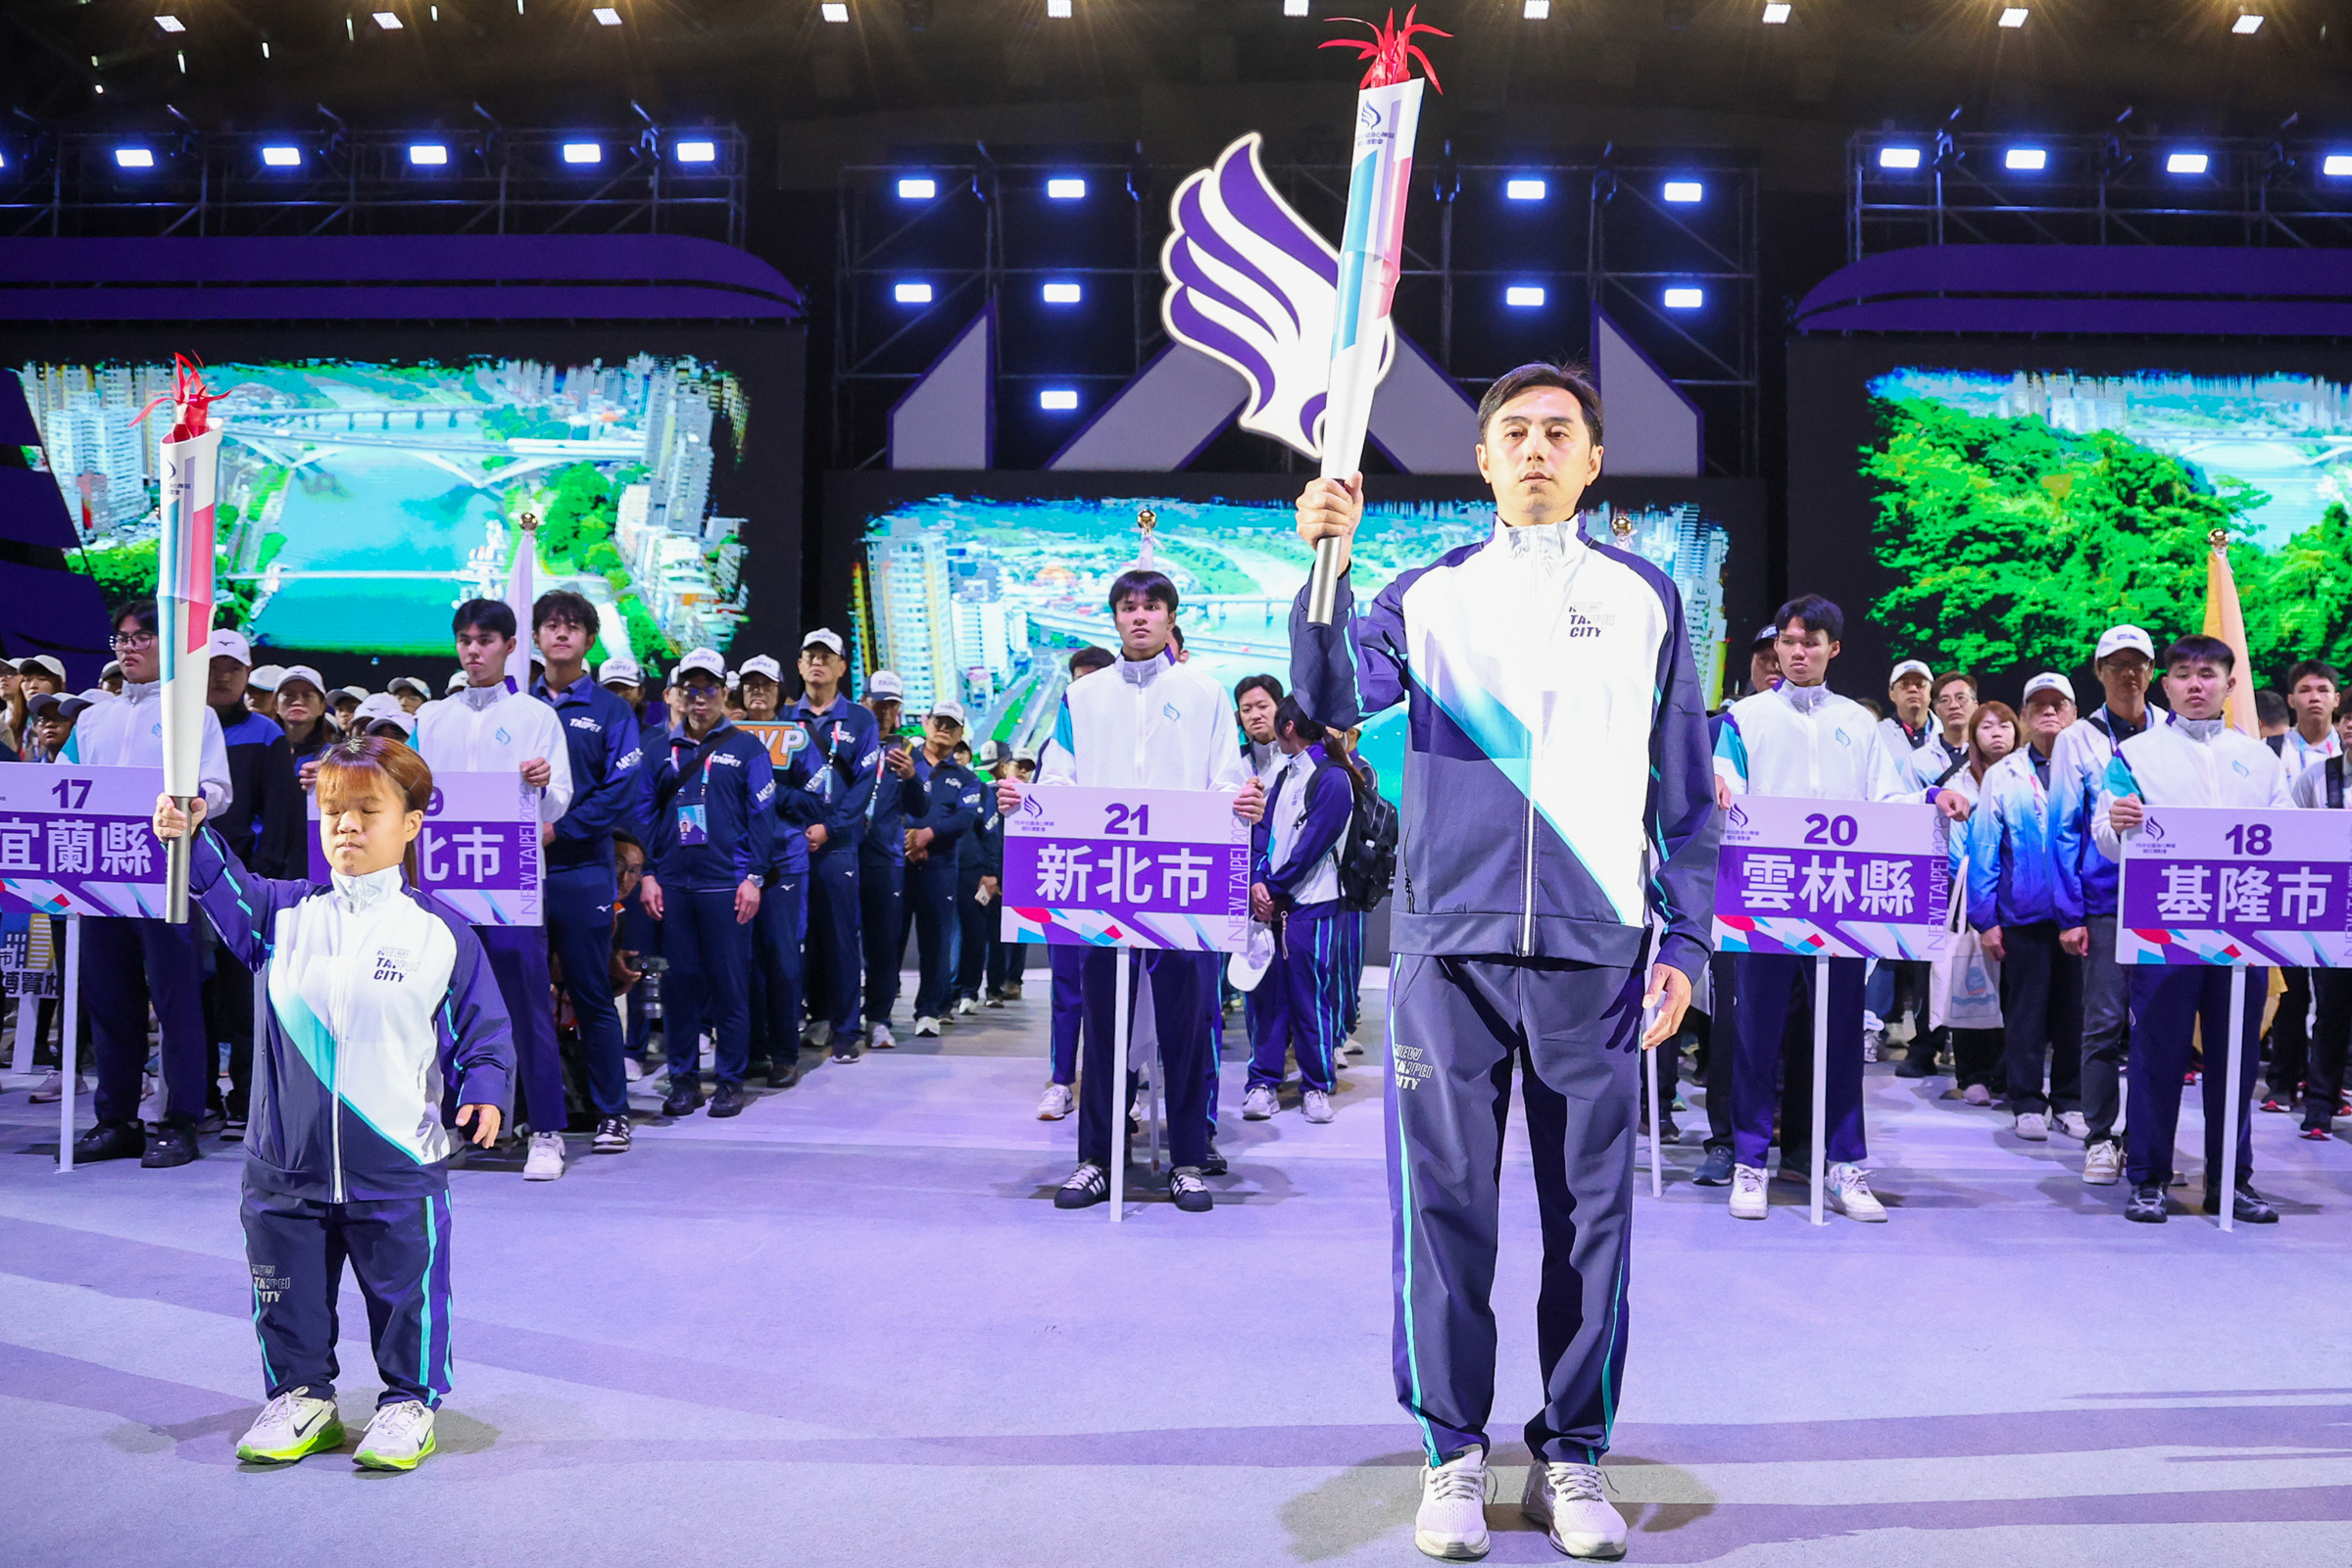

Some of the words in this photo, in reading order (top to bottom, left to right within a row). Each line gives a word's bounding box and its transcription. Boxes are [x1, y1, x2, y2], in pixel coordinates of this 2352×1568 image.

[1569, 602, 1602, 612] NEW
[1571, 614, 1616, 626] TAIPEI
[1569, 626, 1603, 638] CITY
[569, 717, 602, 733] TAIPEI
[52, 779, 93, 809] 17
[1104, 803, 1149, 835] 21
[1804, 813, 1858, 846] 20
[0, 817, 153, 876] 宜蘭縣
[519, 825, 537, 868] TAIPEI
[2226, 823, 2273, 856] 18
[1036, 844, 1213, 906] 新北市
[1229, 848, 1250, 893] TAIPEI
[1740, 854, 1916, 917] 雲林縣
[1929, 859, 1949, 904] TAIPEI
[519, 874, 538, 915] NEW
[2157, 864, 2332, 924] 基隆市
[1227, 896, 1249, 942] NEW
[1927, 906, 1947, 951] NEW
[376, 946, 410, 959] NEW
[376, 956, 421, 972] TAIPEI
[373, 969, 407, 982] CITY
[1395, 1043, 1424, 1061] NEW
[1395, 1058, 1434, 1079] TAIPEI
[254, 1276, 291, 1290] TAIPEI
